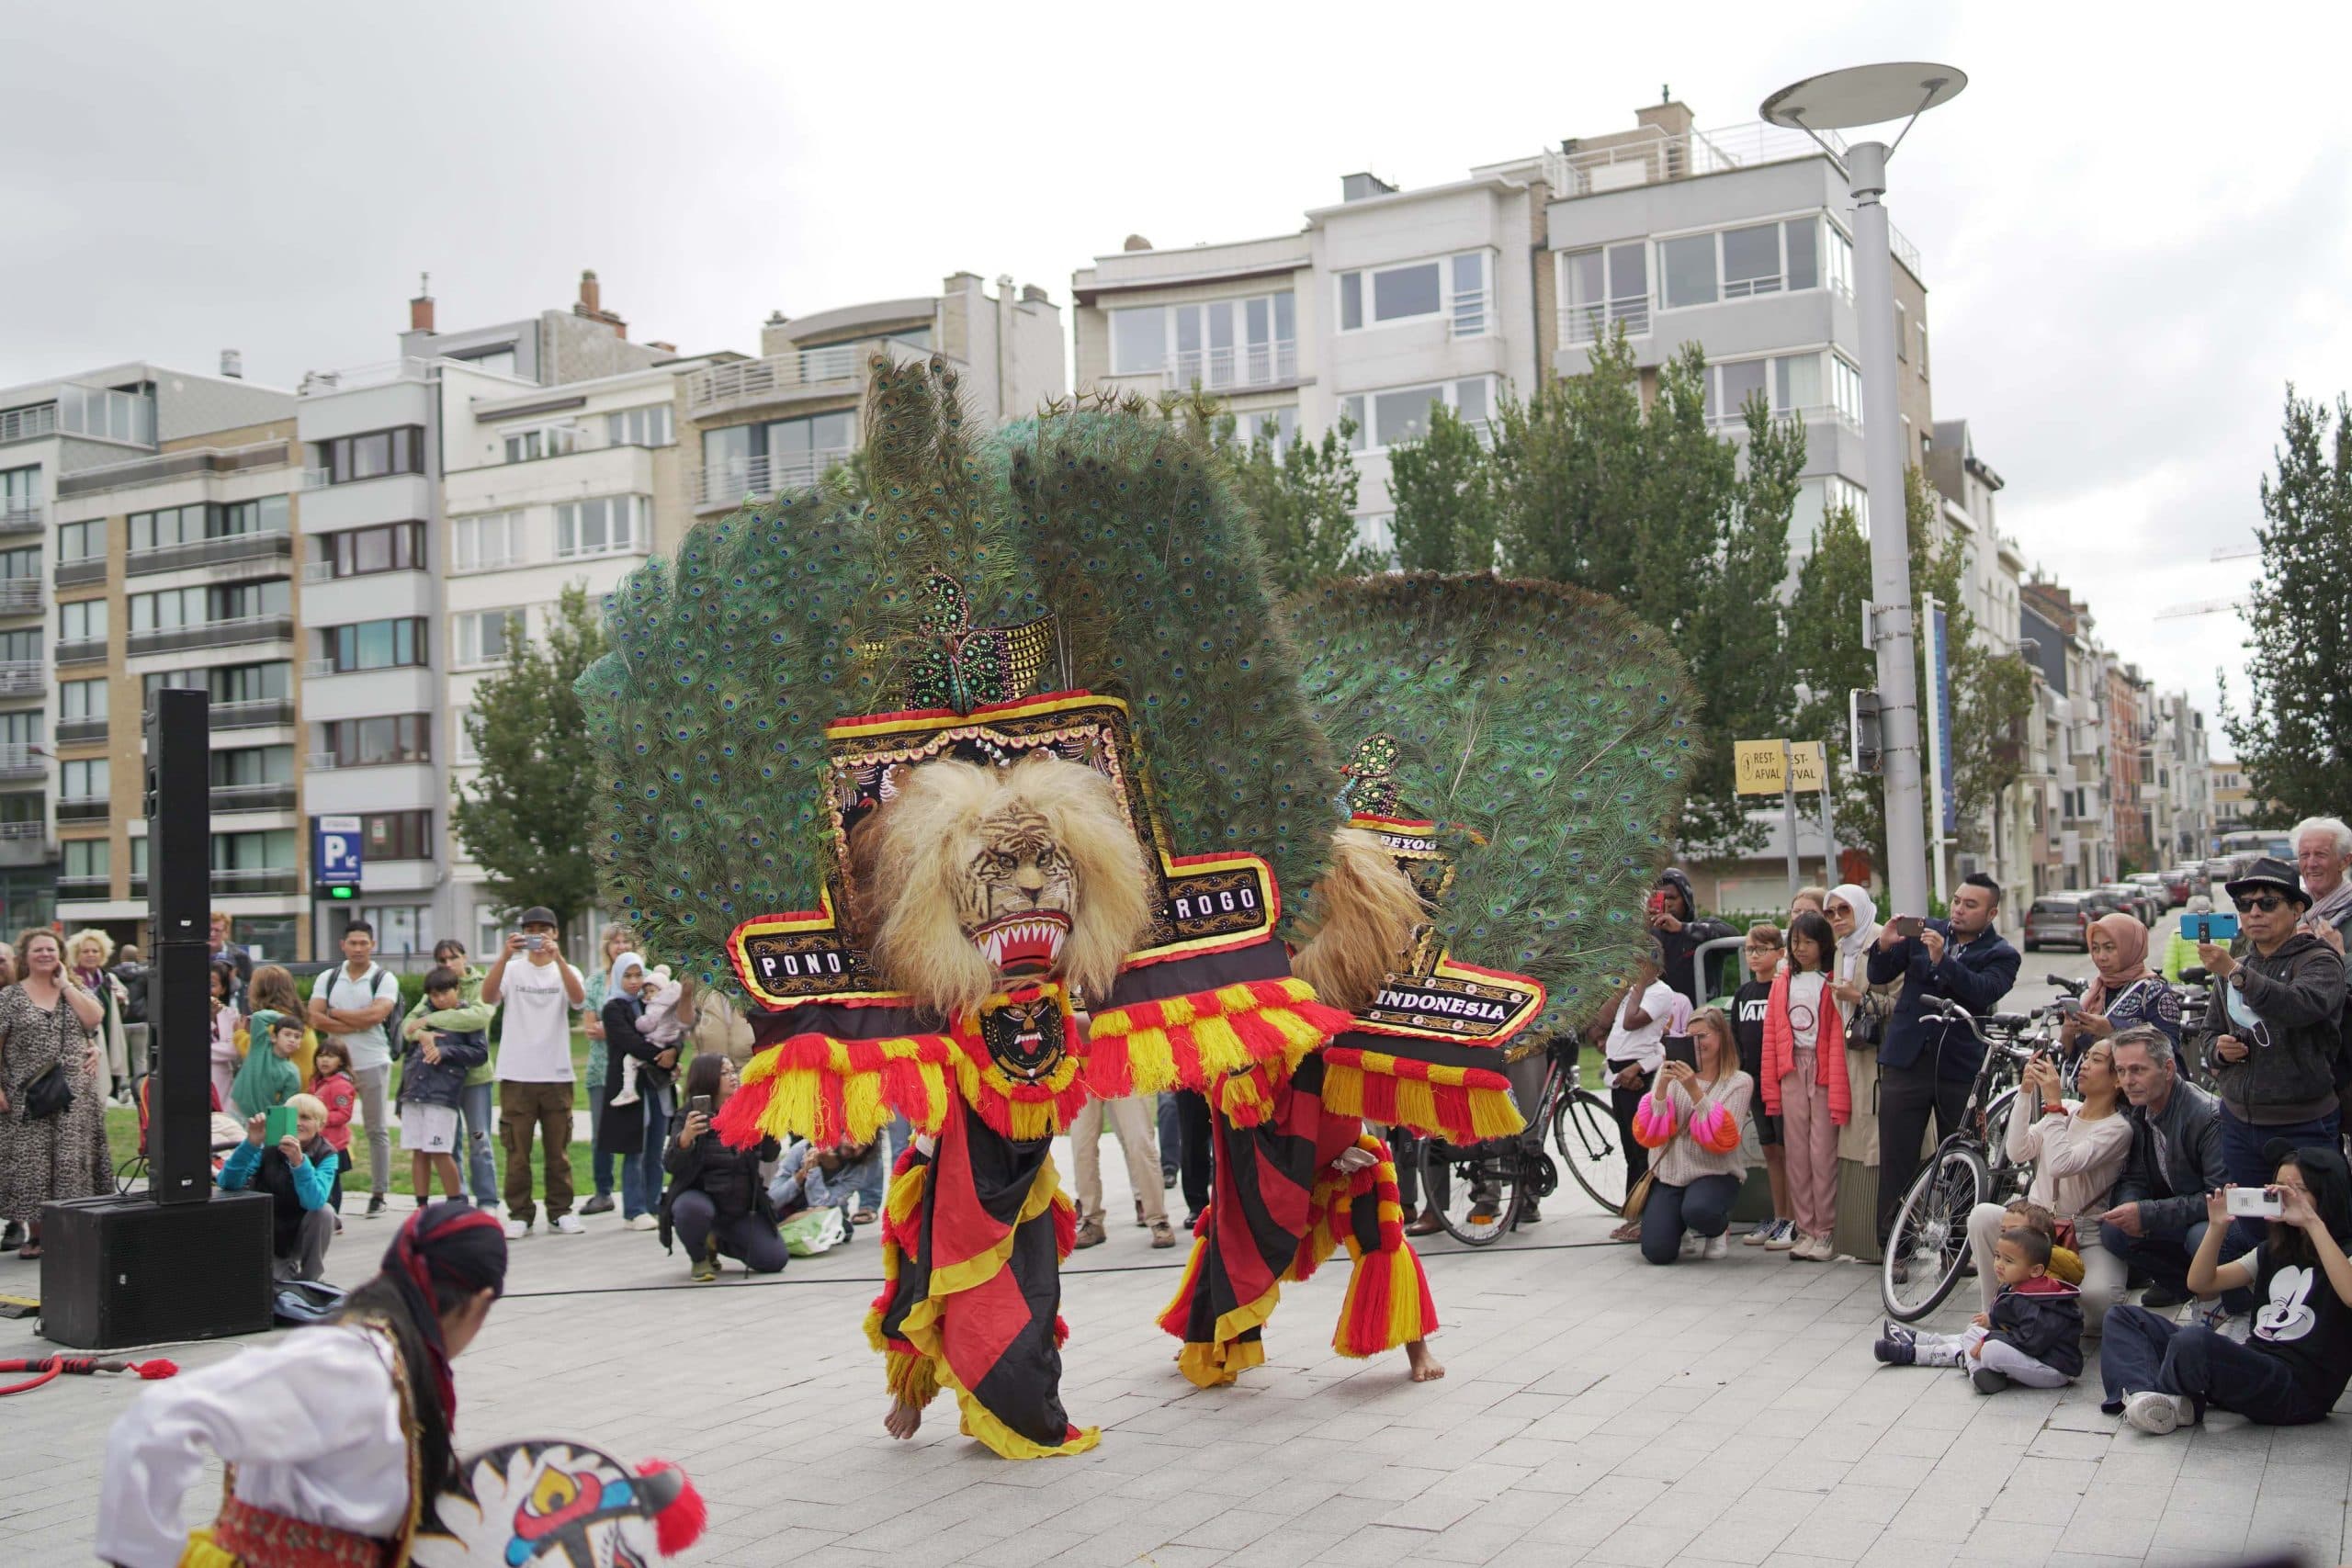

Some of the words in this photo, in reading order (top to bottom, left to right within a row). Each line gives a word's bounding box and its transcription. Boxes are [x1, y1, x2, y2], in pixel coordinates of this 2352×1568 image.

[1753, 752, 1775, 764] REST-
[1790, 753, 1809, 765] EST-
[1755, 769, 1781, 780] AFVAL
[323, 834, 347, 868] P
[1380, 834, 1438, 851] REYOG
[1175, 887, 1255, 919] ROGO
[761, 953, 842, 977] PONO
[1374, 989, 1507, 1020] INDONESIA
[1738, 998, 1769, 1022] VAN
